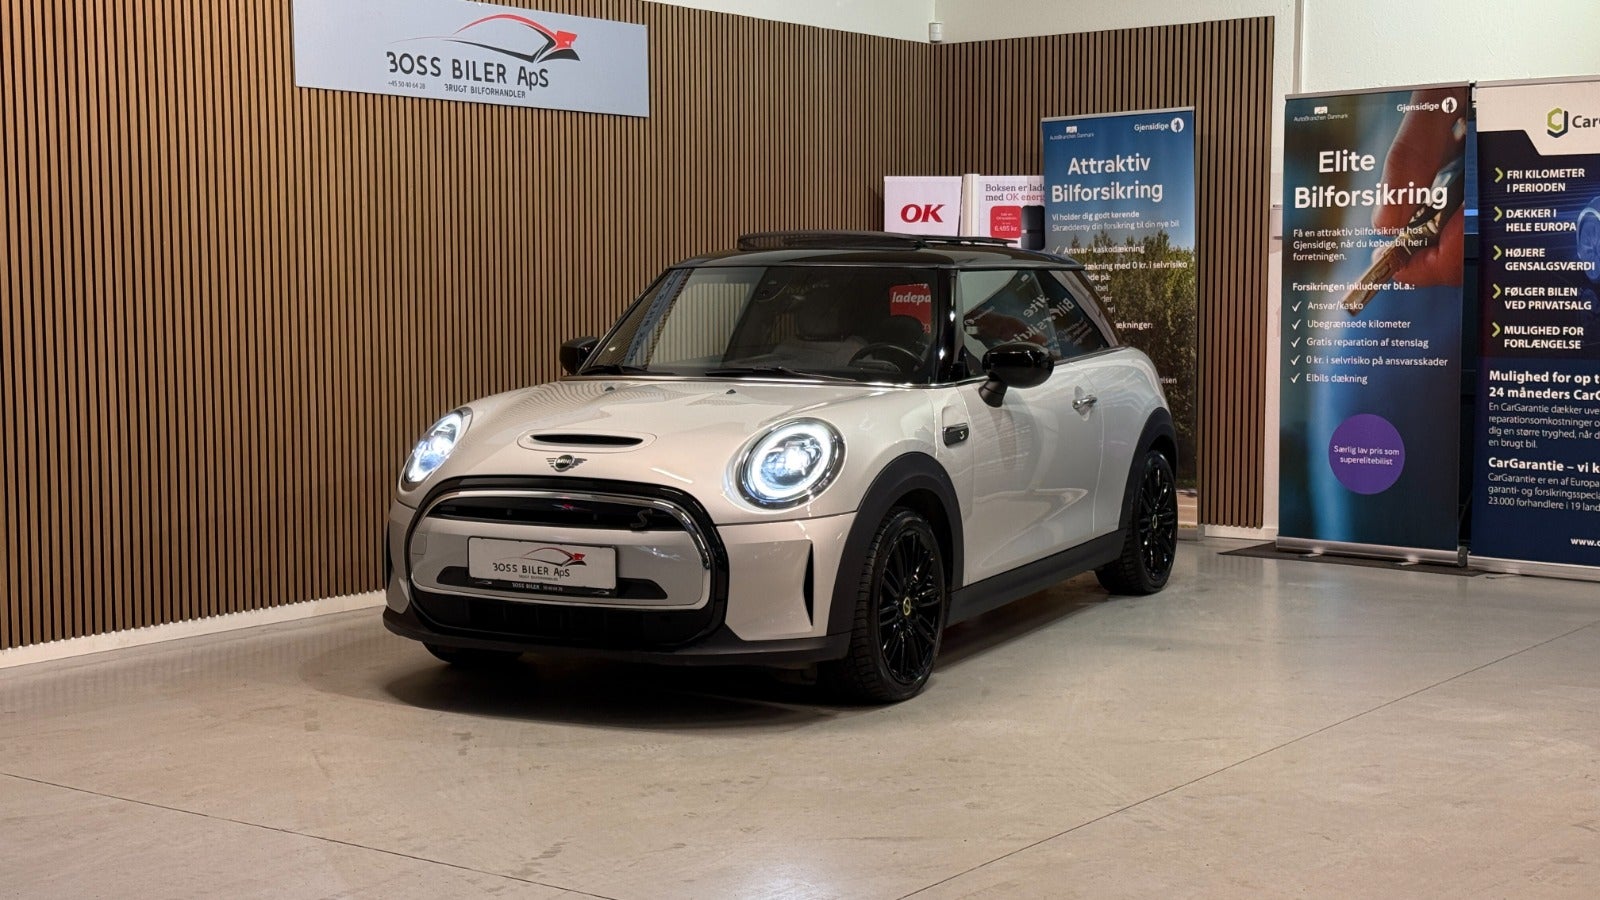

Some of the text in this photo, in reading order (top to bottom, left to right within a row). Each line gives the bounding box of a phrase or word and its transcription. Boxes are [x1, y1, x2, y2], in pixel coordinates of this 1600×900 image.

[452, 59, 507, 84] BILER
[517, 66, 549, 91] ApS
[471, 87, 526, 99] BILFORHANDLER
[1397, 102, 1440, 114] Gjensidige
[1572, 115, 1600, 128] Car
[1134, 123, 1169, 133] Gjensidige
[1068, 153, 1151, 175] Attraktiv
[1319, 149, 1376, 174] Elite
[1507, 168, 1585, 179] FRI KILOMETER
[986, 184, 1016, 192] Boksen
[1052, 180, 1163, 203] Bilforsikring
[1507, 183, 1566, 193] I PERIODEN
[1294, 182, 1448, 210] Bilforsikring
[901, 204, 945, 223] OK
[1082, 212, 1093, 221] dig
[1095, 212, 1110, 221] godt
[1506, 209, 1556, 218] DÆKKER I
[1092, 222, 1103, 230] din
[1104, 221, 1135, 230] forsikring
[1506, 222, 1577, 232] HELE EUROPA
[1294, 229, 1303, 237] Få
[1317, 228, 1353, 237] attraktiv
[1354, 227, 1404, 237] bilforsikring
[1406, 227, 1423, 235] hos
[1093, 245, 1144, 254] kaskodækning
[1293, 241, 1339, 251] Gjensidige,
[1356, 240, 1367, 248] du
[1395, 239, 1406, 247] bil
[1408, 239, 1423, 247] her
[1293, 253, 1347, 262] forretningen.
[1505, 248, 1545, 258] HØJERE
[1114, 262, 1130, 270] med
[1153, 261, 1187, 269] selvrisiko
[1505, 262, 1595, 271] GENSALGSVÆRDI
[1292, 283, 1345, 293] Forsikringen
[1346, 282, 1392, 290] inkluderer
[1505, 287, 1578, 297] FØLGER BILEN
[1308, 301, 1364, 311] Ansvar/kasko
[1505, 301, 1592, 310] VED PRIVATSALG
[1307, 320, 1411, 330] Ubegrænsede kilometer
[1504, 326, 1584, 336] MULIGHED FOR
[1307, 337, 1429, 349] Gratis reparation af stenslag
[1504, 339, 1581, 349] FORLÆNGELSE
[1331, 357, 1370, 365] selvrisiko
[1372, 356, 1384, 367] på
[1386, 357, 1448, 367] ansvarsskader
[1306, 374, 1368, 384] Elbils dækning
[1489, 370, 1549, 385] Mulighed
[1552, 372, 1571, 383] for
[1574, 374, 1591, 386] op
[1489, 387, 1570, 400] 24 måneders
[1501, 403, 1549, 413] CarGarantie
[1551, 405, 1582, 415] dækker
[1489, 416, 1592, 428] reparationsomkostninger
[1489, 427, 1501, 436] dig
[1542, 430, 1577, 440] tryghed,
[1579, 430, 1592, 439] når
[1501, 439, 1524, 449] brugt
[1526, 440, 1537, 448] bil.
[1334, 446, 1356, 455] Særlig
[1340, 457, 1393, 465] superelitebilist
[1489, 457, 1564, 471] CarGarantie
[1578, 462, 1588, 473] vi
[1488, 473, 1536, 484] CarGarantie
[1561, 477, 1569, 486] af
[1570, 478, 1600, 489] Europa
[1488, 486, 1520, 495] garanti-
[1522, 489, 1532, 497] og
[1488, 497, 1515, 506] 23.000
[1517, 499, 1564, 510] forhandlere
[1572, 502, 1581, 510] 19
[522, 565, 549, 575] BILER
[554, 569, 570, 578] ApS
